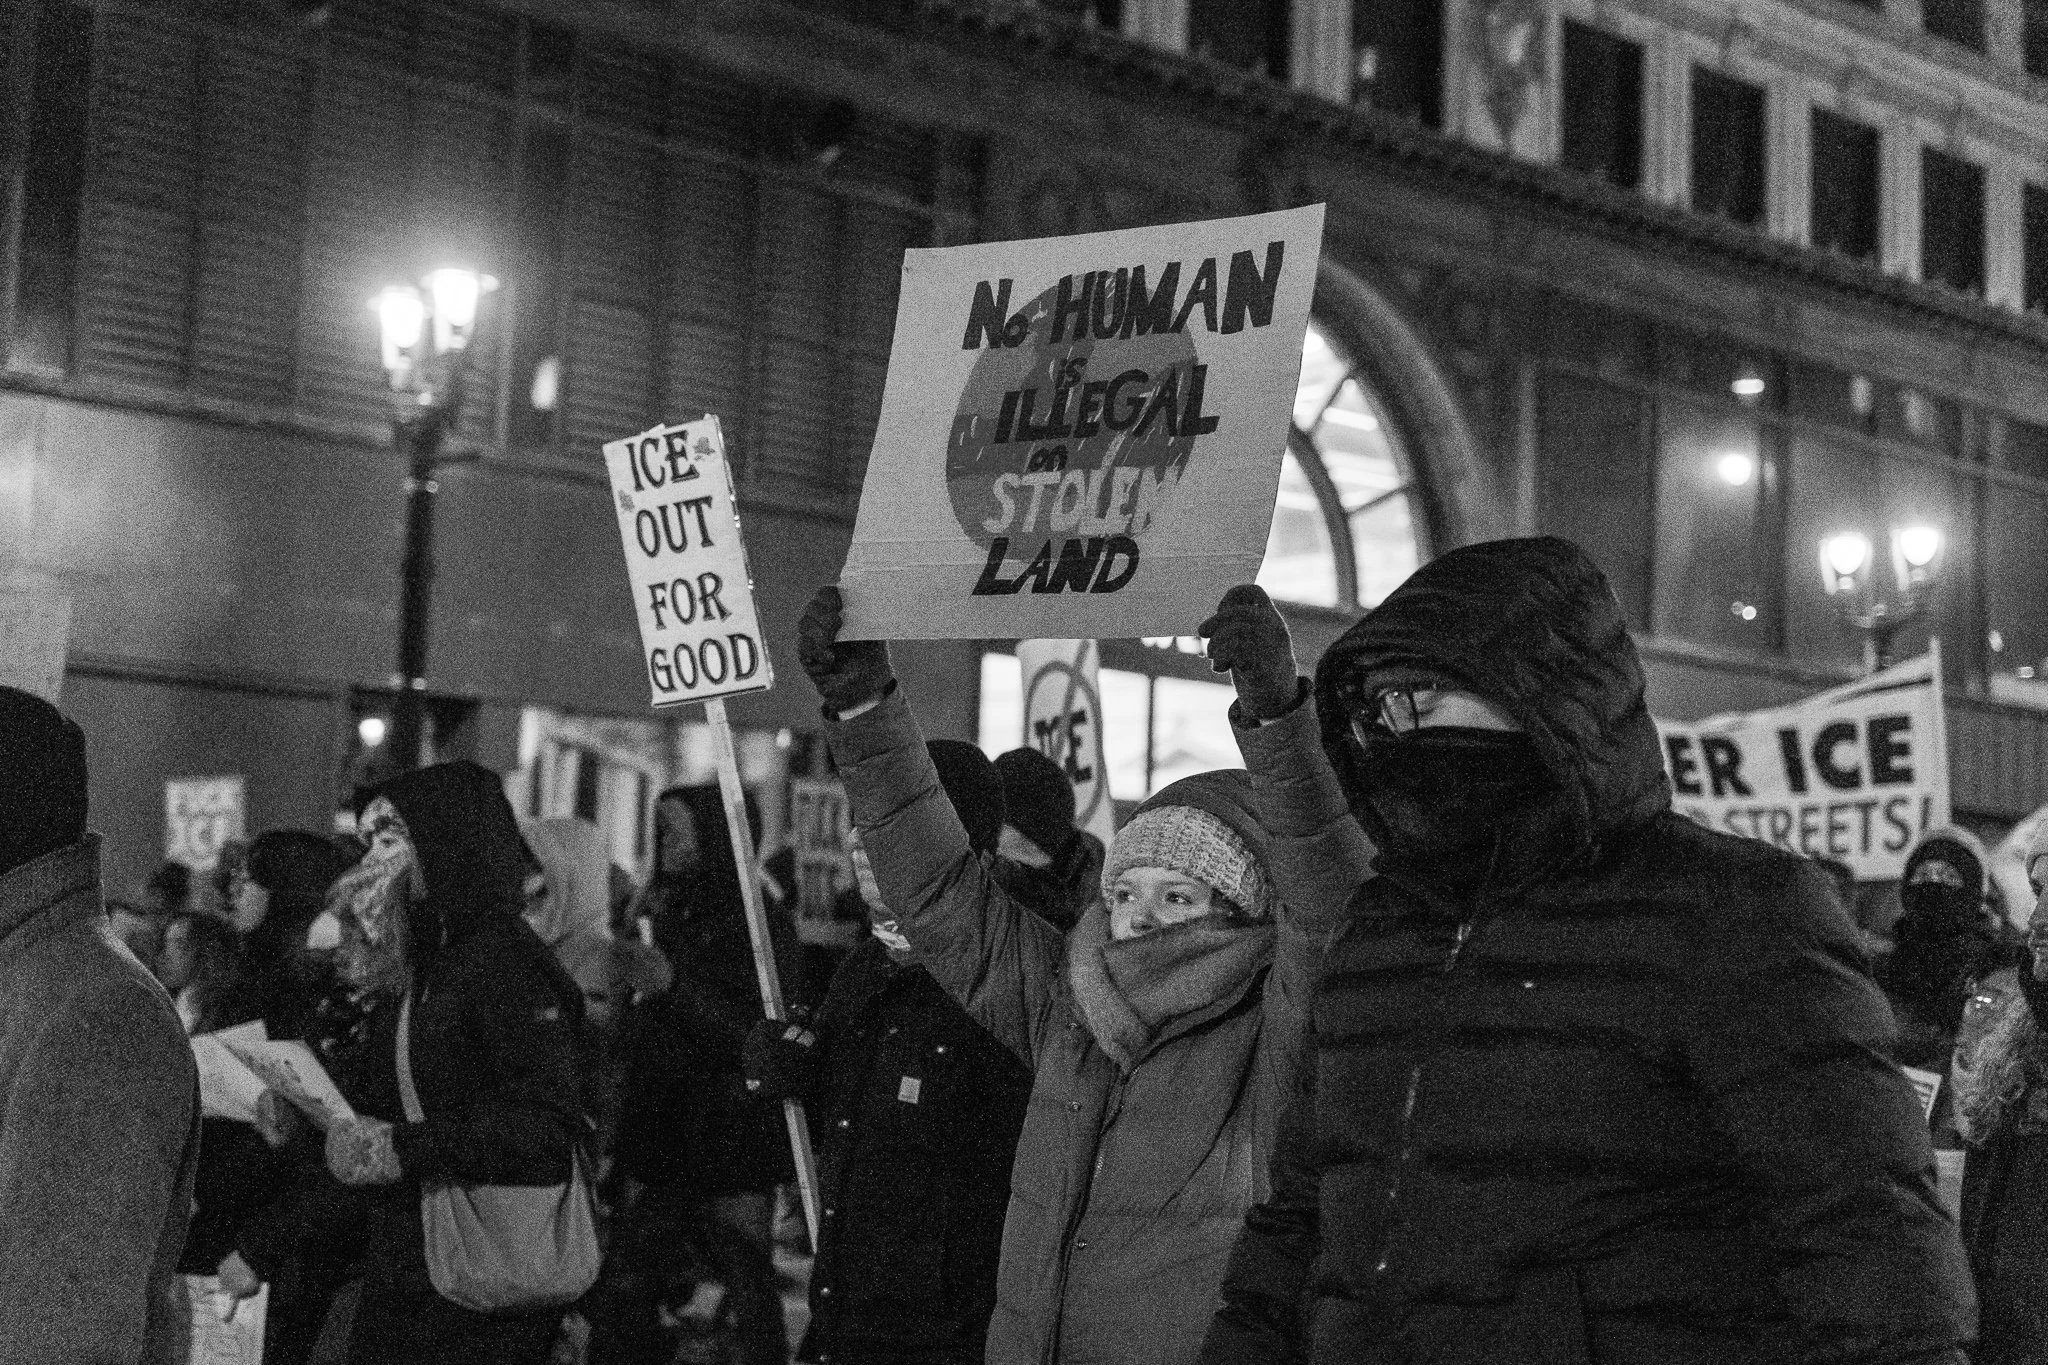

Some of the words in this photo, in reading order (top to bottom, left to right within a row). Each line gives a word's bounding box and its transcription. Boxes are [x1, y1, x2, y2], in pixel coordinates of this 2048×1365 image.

[1050, 240, 1285, 345] HUMAN
[993, 364, 1220, 444] ILLEGAL
[625, 430, 700, 493] ICE
[635, 495, 715, 558] OUT
[981, 465, 1182, 535] STOLEN
[971, 536, 1140, 596] LAND
[648, 572, 732, 630] FOR
[650, 633, 760, 693] GOOD
[1665, 735, 1753, 797] ER
[1778, 714, 1915, 795] ICE
